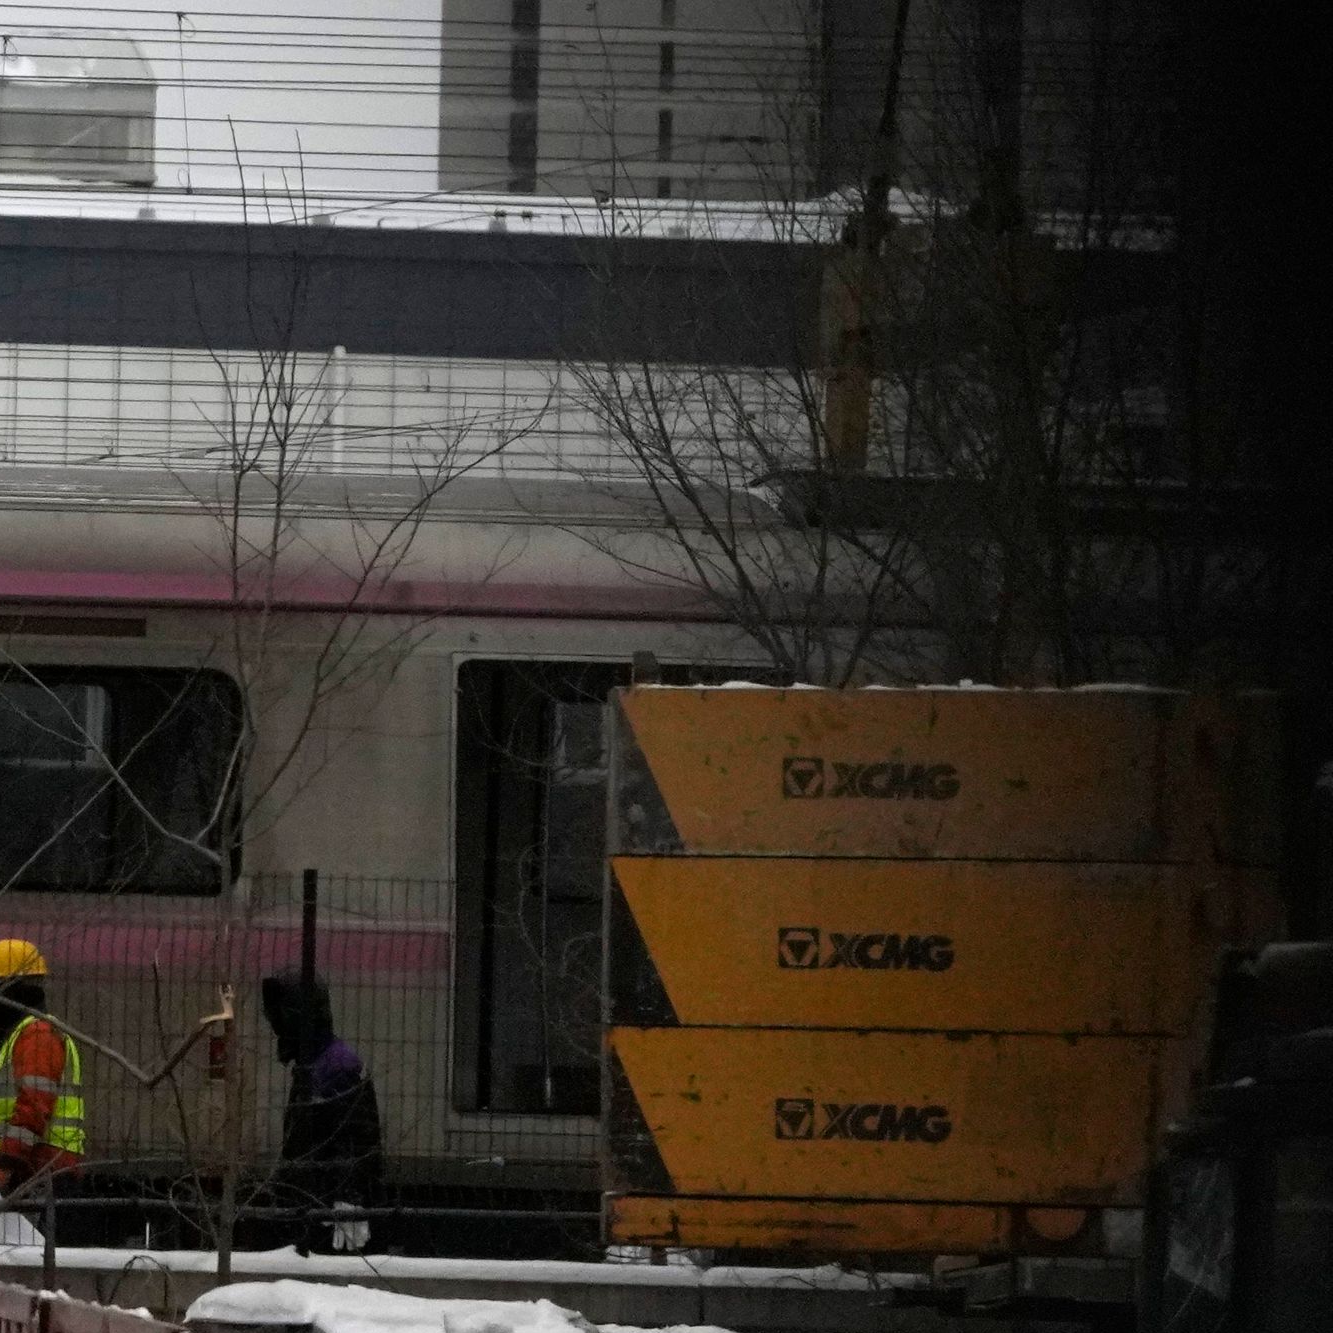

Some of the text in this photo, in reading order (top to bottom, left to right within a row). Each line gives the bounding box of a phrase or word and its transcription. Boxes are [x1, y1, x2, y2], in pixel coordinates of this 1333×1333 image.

[831, 762, 961, 800] XCMG
[823, 933, 955, 972] XCMG
[821, 1104, 951, 1143] XCMG
